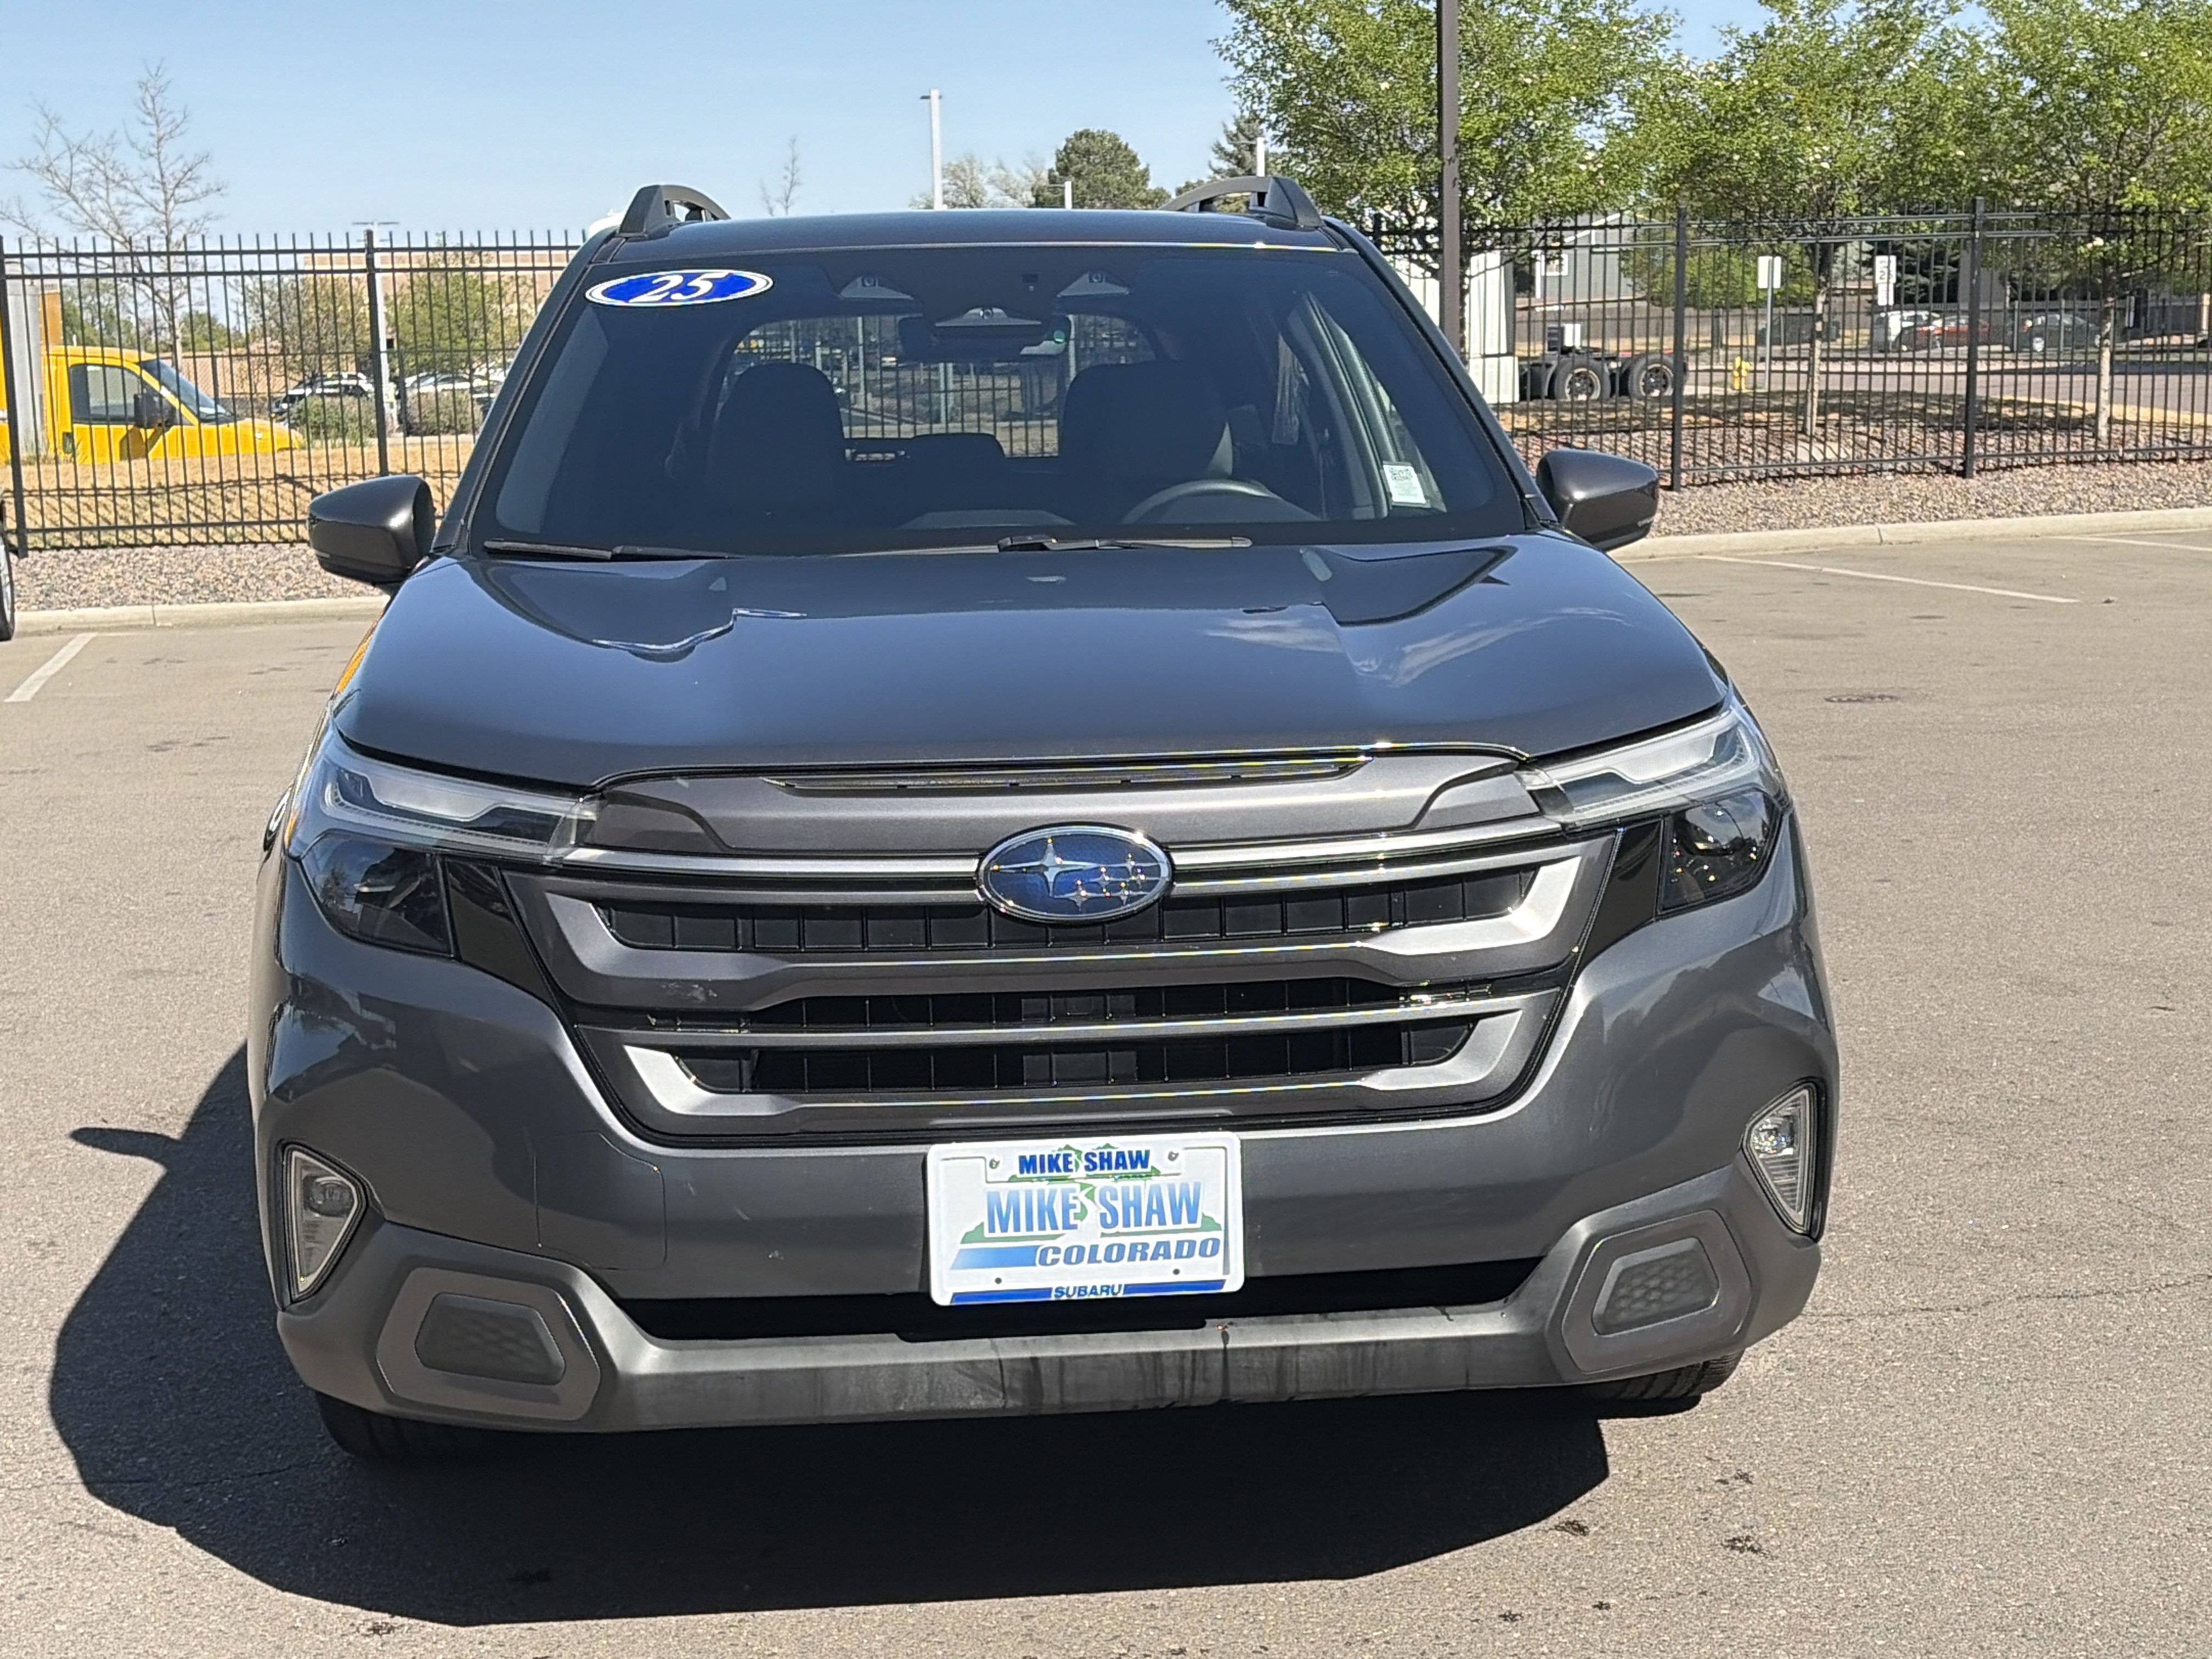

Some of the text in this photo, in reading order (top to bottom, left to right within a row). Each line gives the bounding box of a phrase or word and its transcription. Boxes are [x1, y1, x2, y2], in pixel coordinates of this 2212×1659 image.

[628, 272, 729, 303] 25
[1018, 1149, 1151, 1175] MIKE SHAW
[986, 1182, 1202, 1233] MIKE SHAW
[1038, 1238, 1221, 1267] COLORADO
[1053, 1284, 1122, 1299] SUBARU
